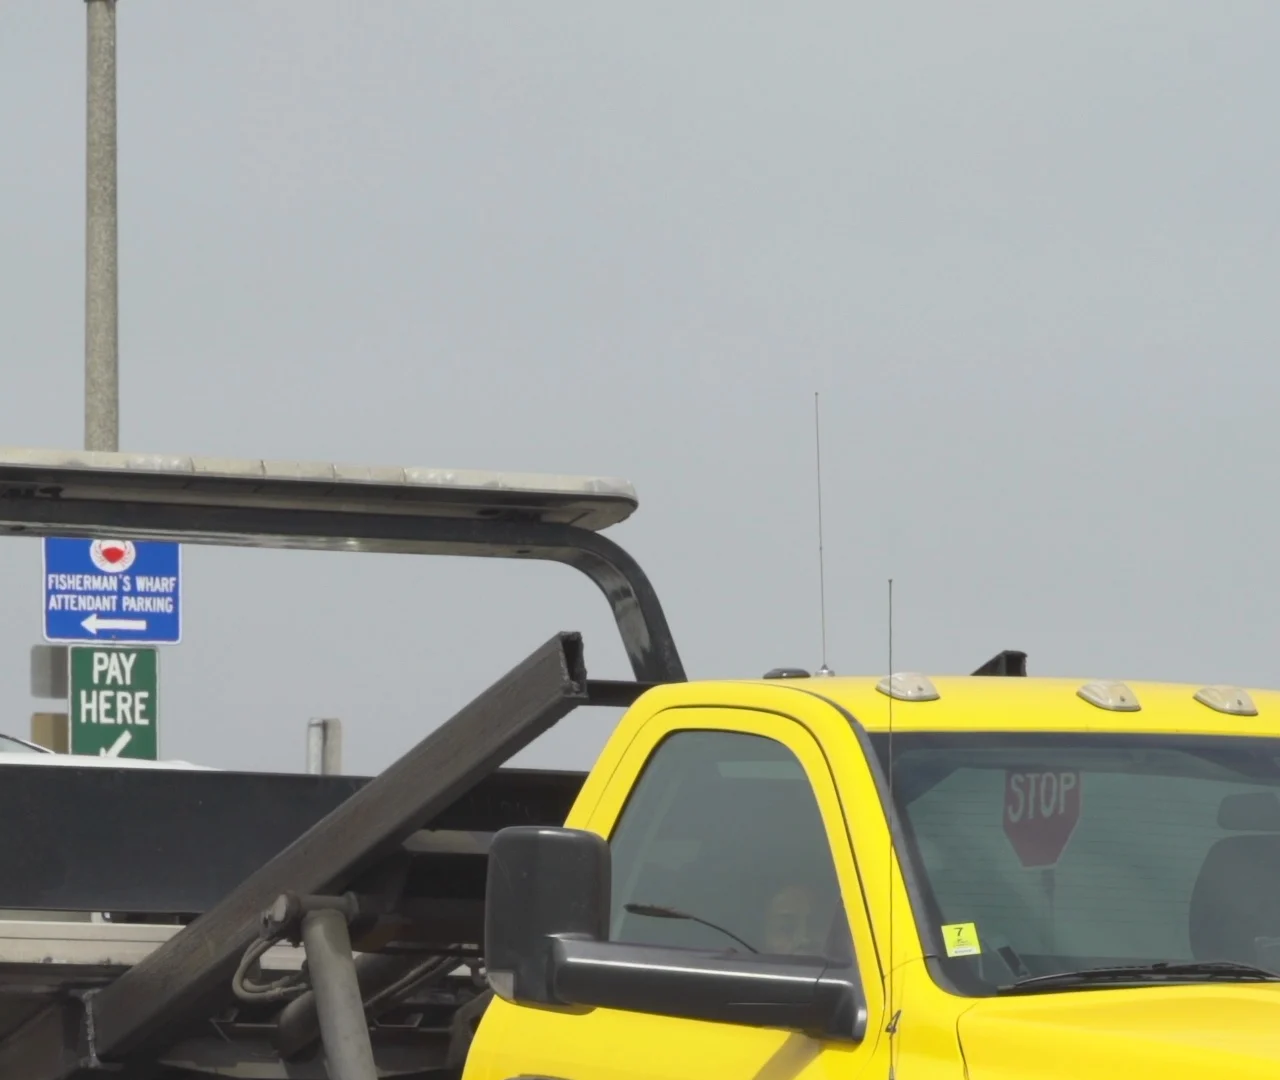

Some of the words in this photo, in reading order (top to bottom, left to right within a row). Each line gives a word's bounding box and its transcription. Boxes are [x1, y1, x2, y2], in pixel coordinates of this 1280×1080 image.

[48, 573, 131, 591] FISHERMAN'S
[136, 575, 177, 593] WHARF
[49, 594, 117, 611] ATTENDANT
[122, 596, 173, 613] PARKING
[93, 652, 136, 686] PAY
[80, 690, 149, 725] HERE
[1007, 771, 1076, 823] STOP
[953, 927, 963, 936] 7
